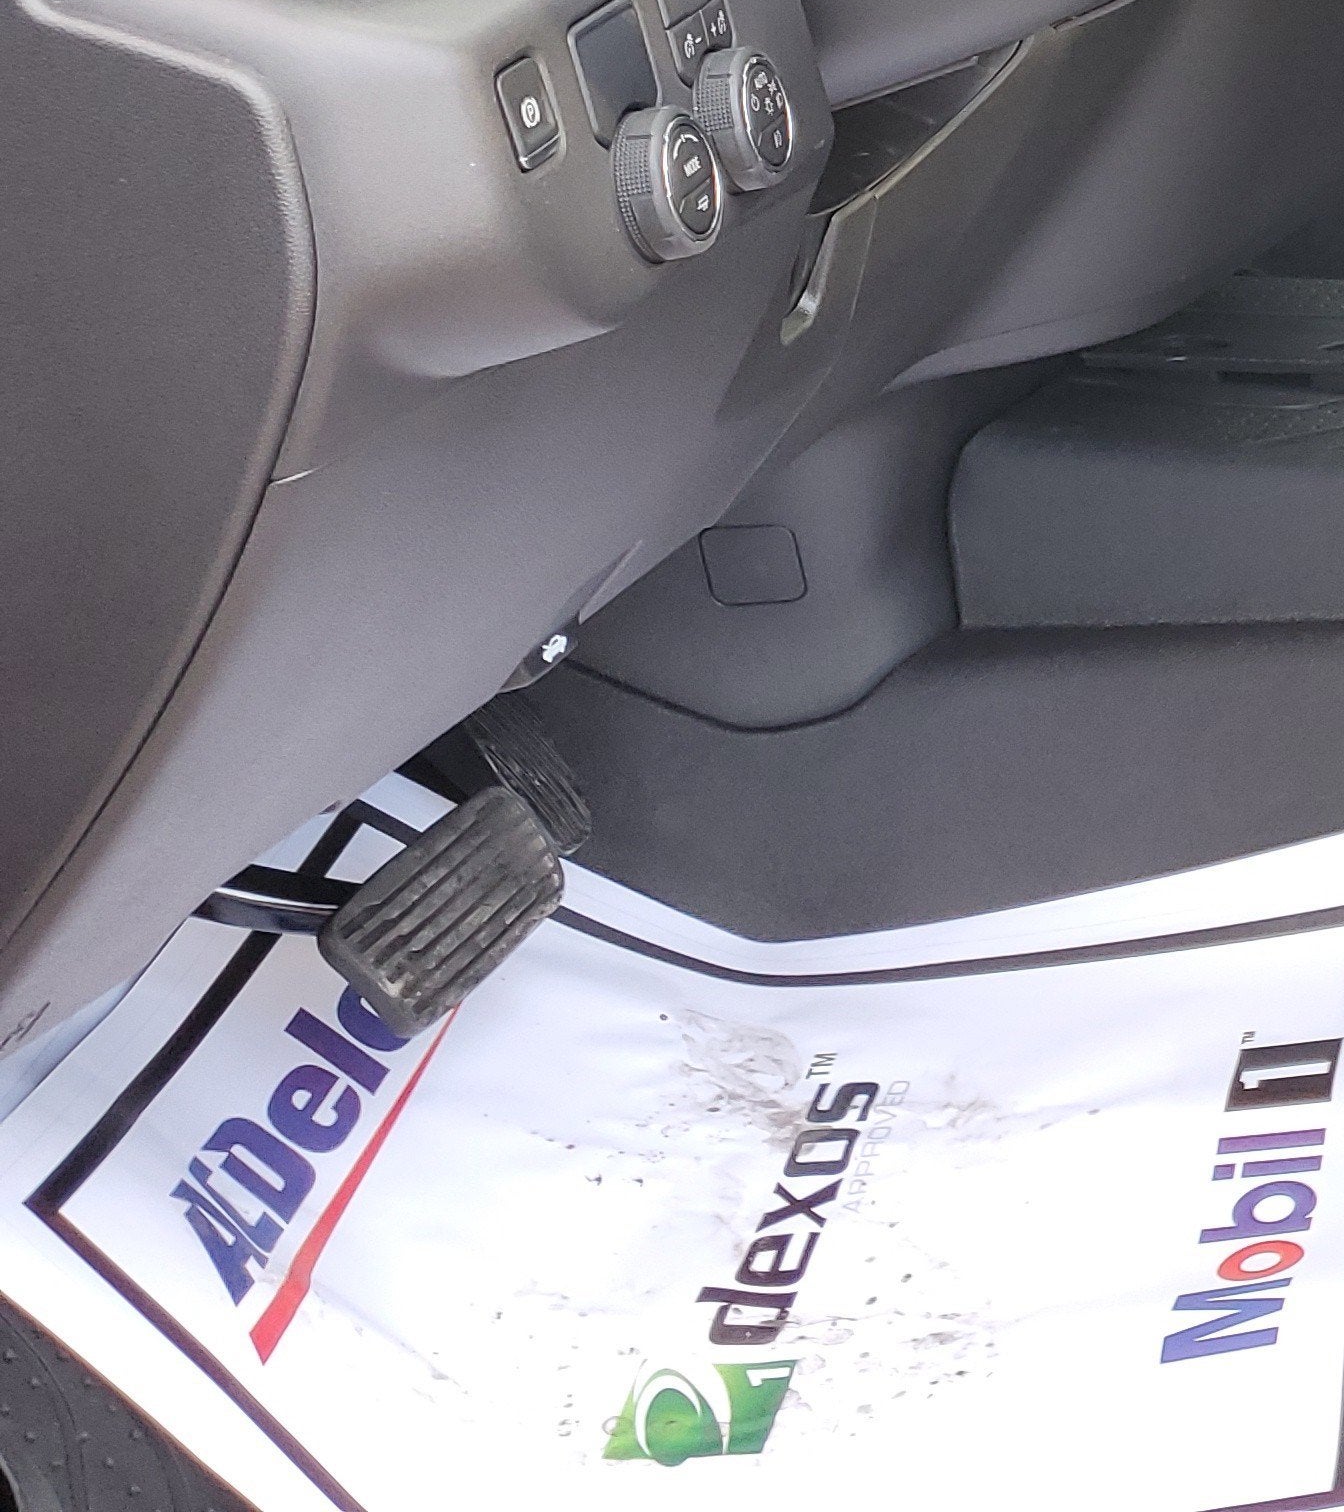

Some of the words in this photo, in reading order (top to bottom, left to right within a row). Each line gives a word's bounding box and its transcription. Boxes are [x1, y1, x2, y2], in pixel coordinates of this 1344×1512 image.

[696, 1080, 881, 1346] dexos
[842, 1080, 910, 1214] APPROVED
[1160, 1127, 1327, 1364] Mobil
